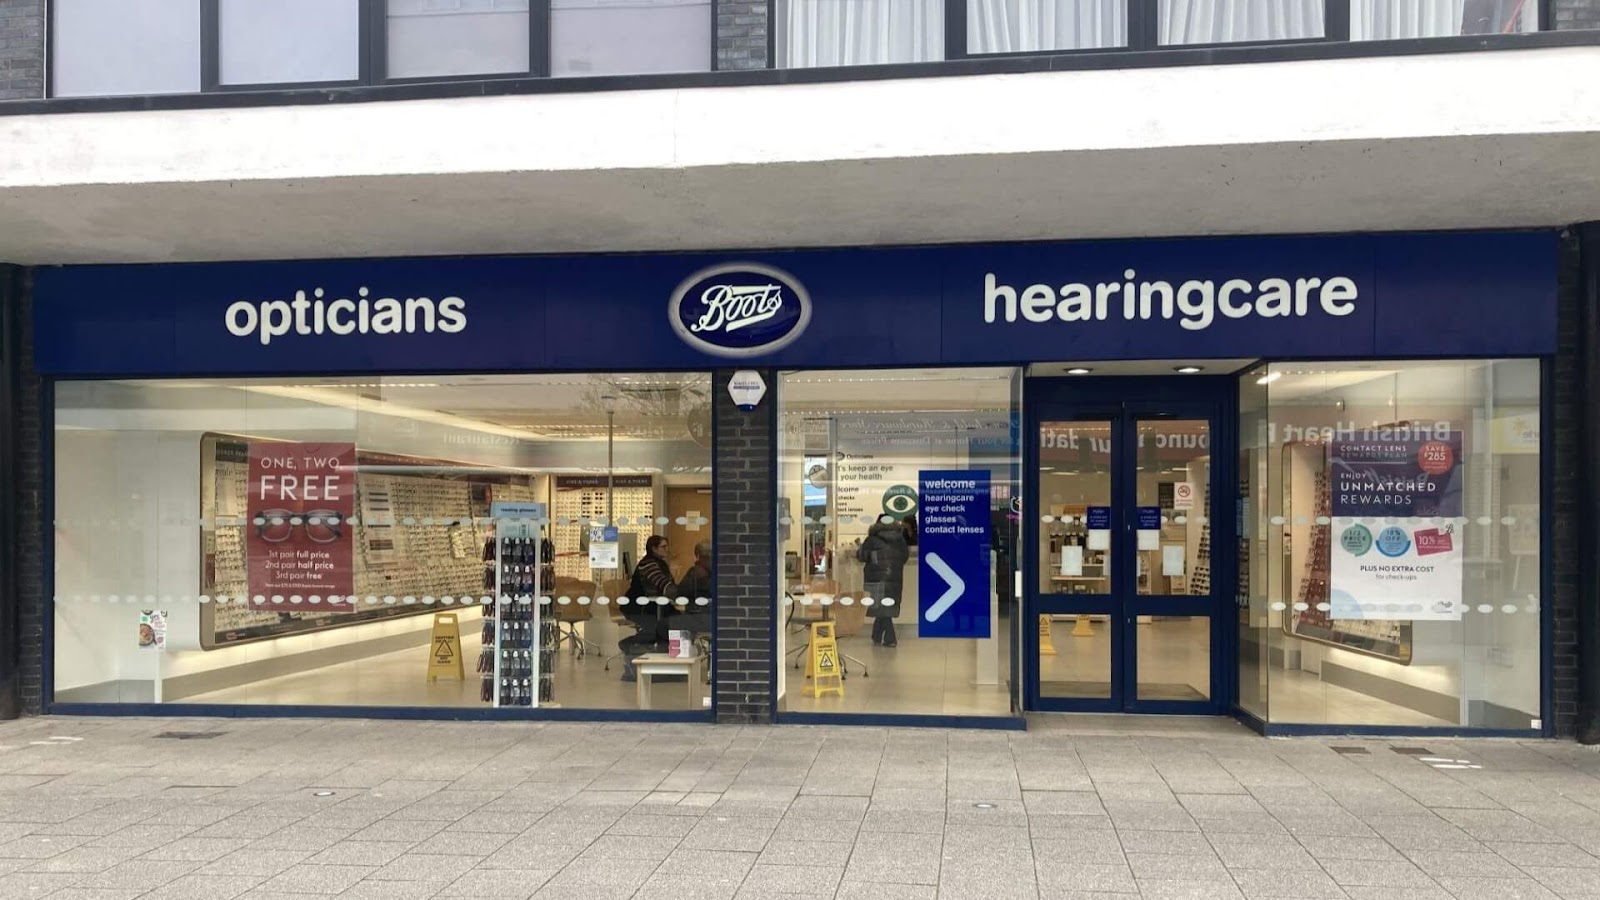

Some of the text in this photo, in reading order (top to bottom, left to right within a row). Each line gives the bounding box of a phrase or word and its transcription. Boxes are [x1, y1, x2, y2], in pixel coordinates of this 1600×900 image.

[984, 268, 1358, 331] hearingcare
[690, 284, 782, 332] Boots
[225, 286, 467, 345] opticians
[260, 456, 340, 470] ONE, TWO
[880, 465, 894, 474] eye
[1340, 472, 1366, 480] ENJOY
[260, 474, 340, 500] FREE
[924, 479, 976, 489] welcome
[1340, 482, 1436, 492] UNMATCHED
[924, 494, 975, 503] hearingcare
[1340, 494, 1412, 505] REWARDS
[924, 504, 966, 514] eye check
[924, 516, 957, 525] glasses
[924, 526, 985, 534] contact lenses
[280, 551, 294, 560] pair
[296, 550, 309, 558] full
[310, 550, 330, 559] price
[265, 560, 335, 570] 2nd pair half price
[1415, 565, 1434, 573] COST
[275, 571, 288, 579] 3rd
[289, 572, 305, 580] pair
